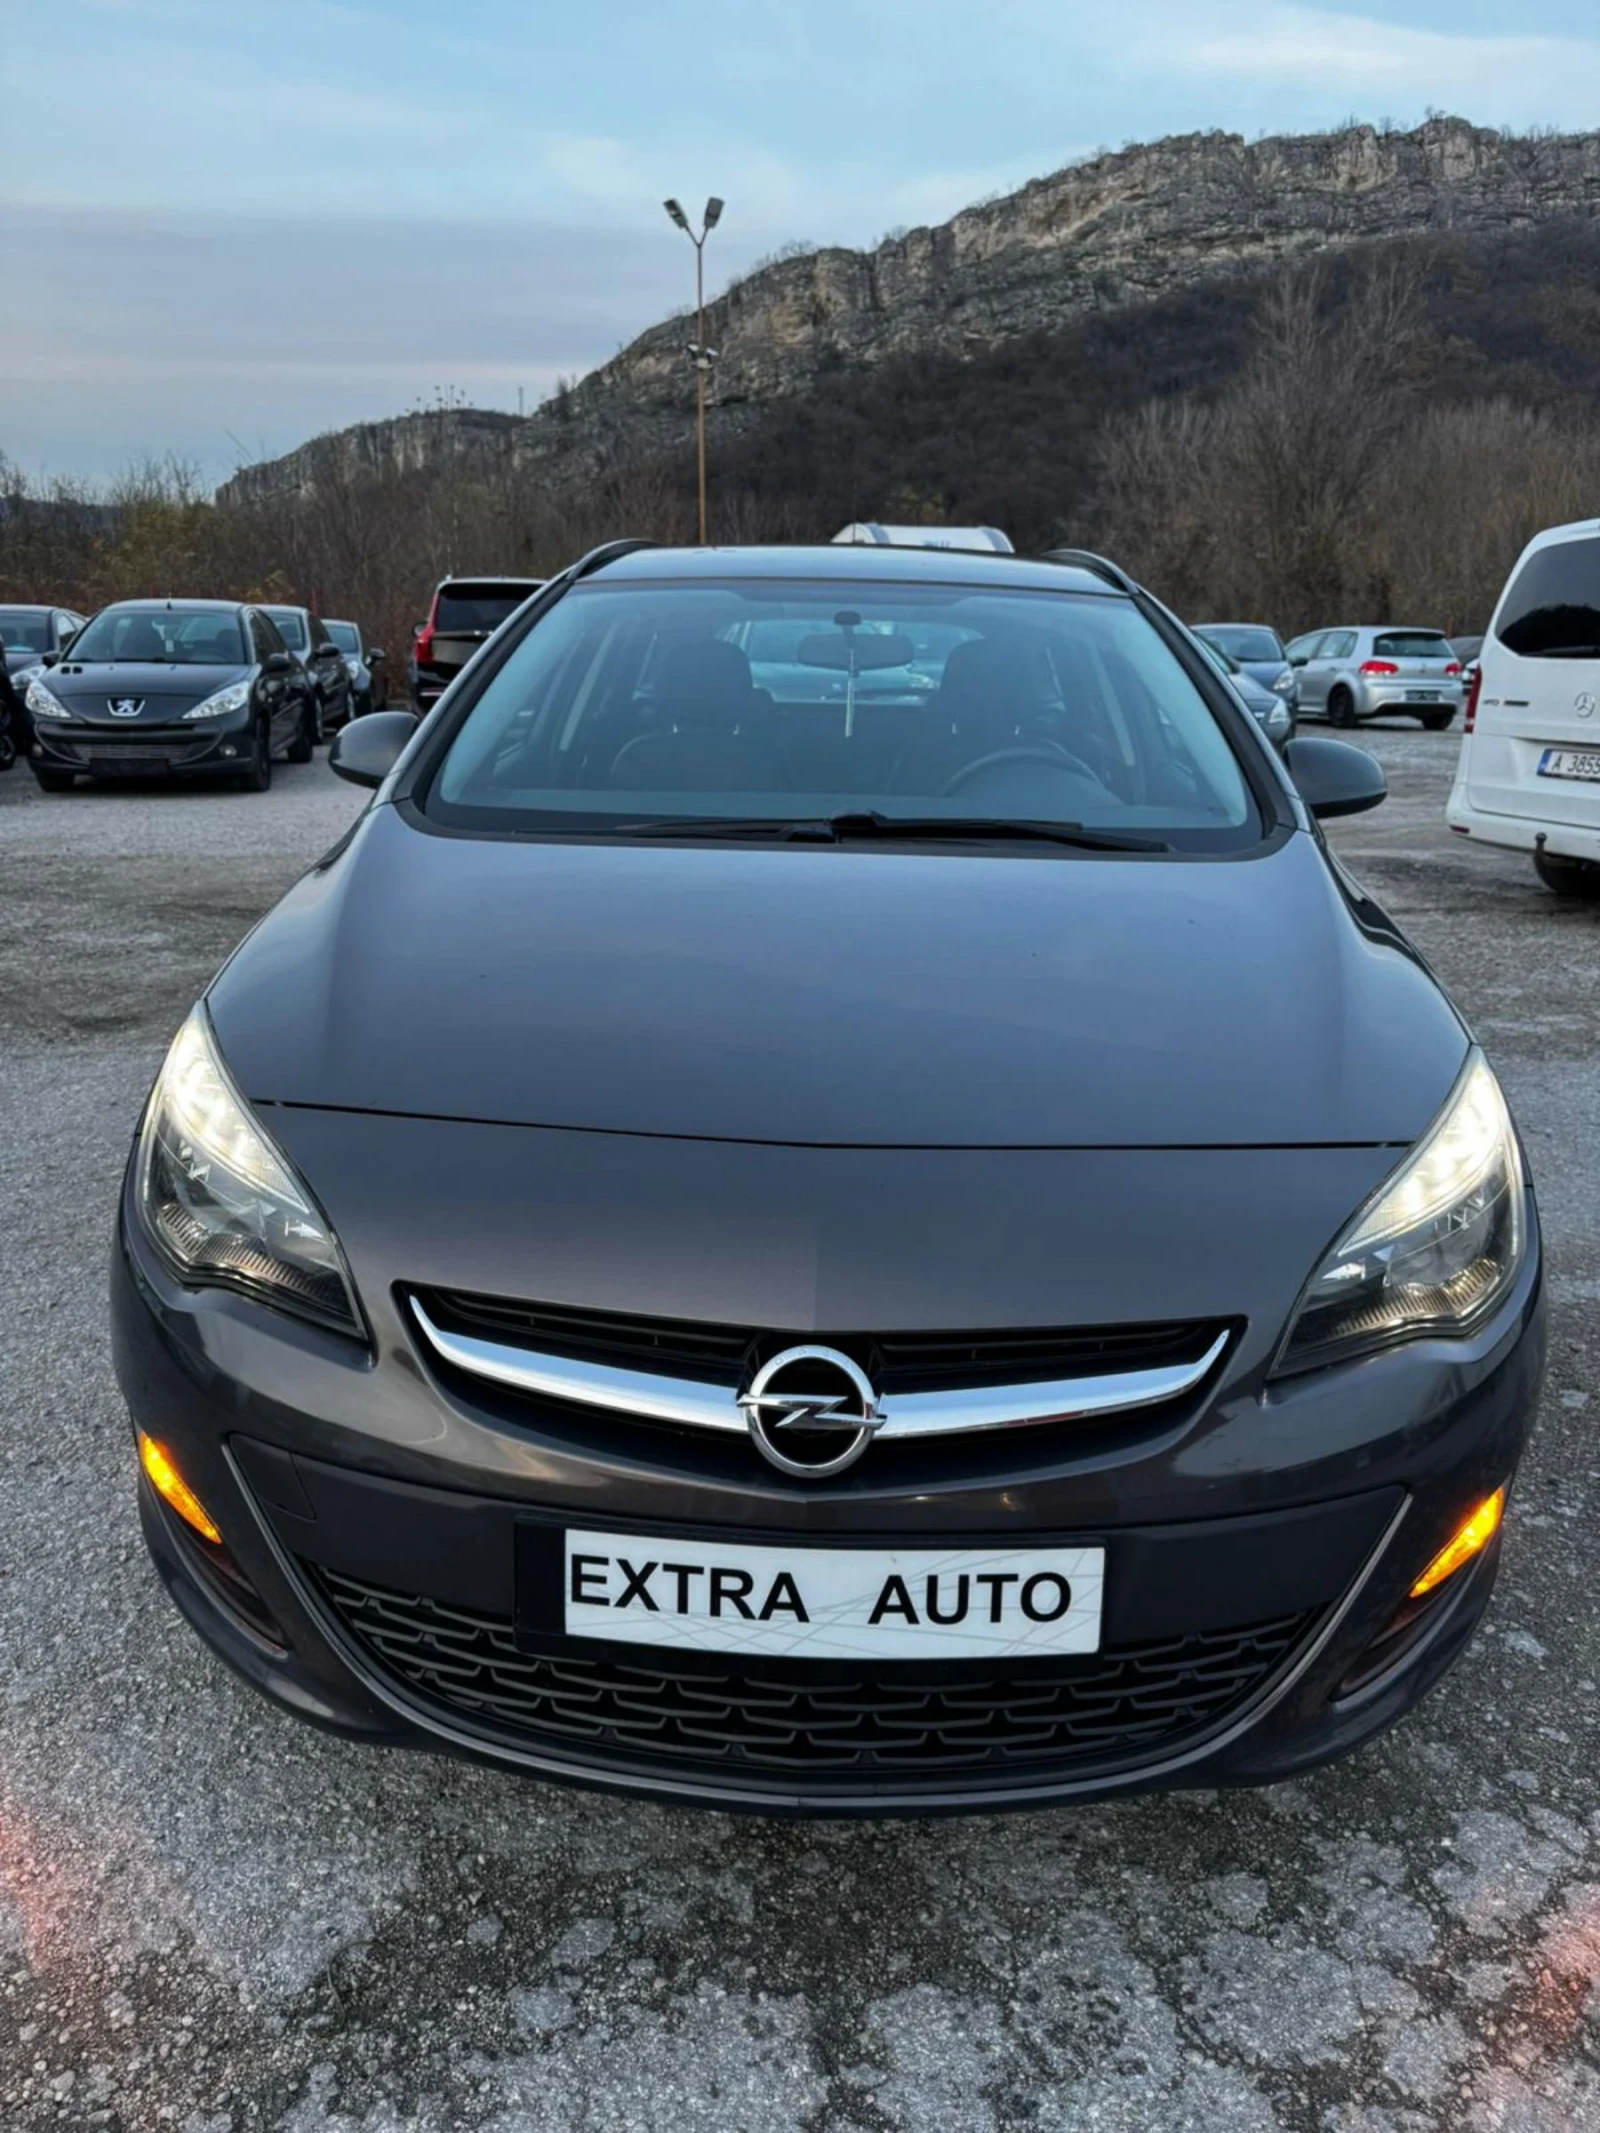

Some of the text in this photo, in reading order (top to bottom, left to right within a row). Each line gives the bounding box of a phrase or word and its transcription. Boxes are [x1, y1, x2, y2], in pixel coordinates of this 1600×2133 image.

[1551, 754, 1563, 771] A
[571, 1554, 1072, 1625] EXTRA AUTO
